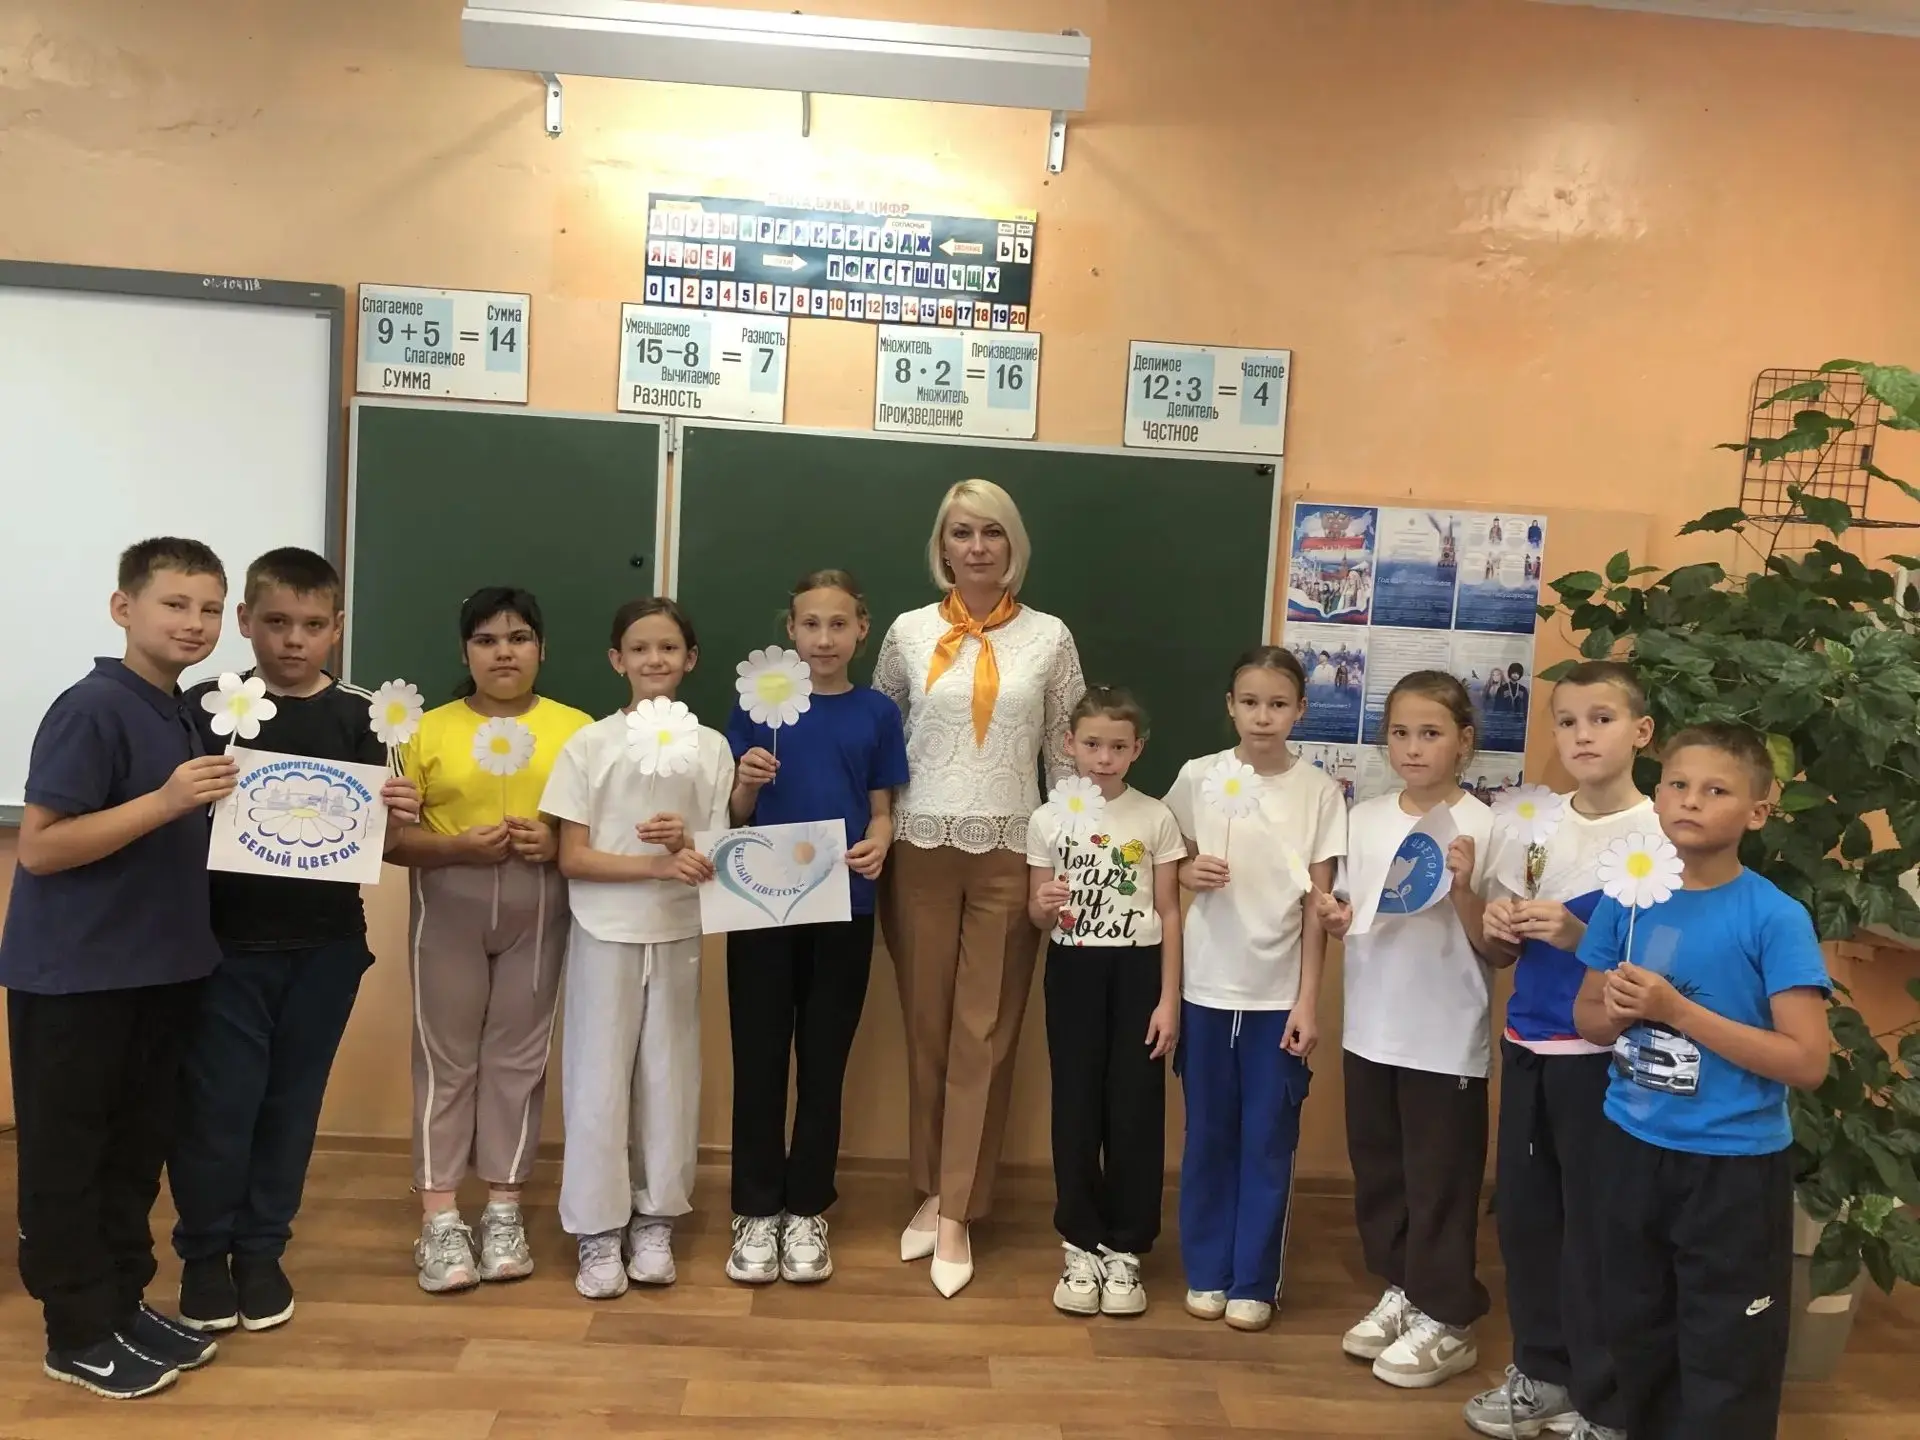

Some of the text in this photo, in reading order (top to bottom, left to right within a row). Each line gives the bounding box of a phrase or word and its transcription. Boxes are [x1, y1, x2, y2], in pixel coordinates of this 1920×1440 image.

[870, 202, 909, 214] ЦИФР
[761, 222, 771, 238] Р
[868, 230, 877, 248] Г
[884, 232, 894, 249] З
[900, 233, 912, 253] Д
[916, 235, 931, 253] Ж
[651, 246, 661, 262] Я
[684, 249, 698, 265] Ю
[722, 251, 732, 267] И
[829, 260, 997, 290] П Ф К С Т Ш Ц Ч Щ Х
[362, 296, 423, 316] Слагаемое
[487, 304, 522, 323] Сумма
[650, 283, 1026, 325] 0 1 2 3 4 5 6 7 8 9 10 11 12 13 14 15 16 17 18 19 20
[625, 317, 691, 338] Уменьшаемое
[742, 327, 786, 346] Разность
[490, 326, 516, 353] 14
[880, 337, 933, 355] Множитель
[404, 346, 466, 366] Слагаемое
[758, 347, 774, 373] 7
[971, 342, 1038, 361] Произведение
[1133, 354, 1182, 372] Делимое
[1241, 361, 1285, 379] Частное
[661, 366, 721, 386] Вычитаемое
[996, 363, 1023, 390] 16
[633, 384, 702, 409] Разность
[916, 386, 969, 405] Множитель
[1253, 381, 1269, 407] 4
[879, 403, 963, 428] Произведение
[1167, 401, 1219, 420] Делитель
[1142, 420, 1199, 443] Частное
[239, 761, 373, 803] БЛАГОТВОРИТЕЛЬНАЯ АКЦИЯ
[238, 831, 360, 871] БЕЛЫЙ ЦВЕТОК
[1075, 909, 1145, 938] best
